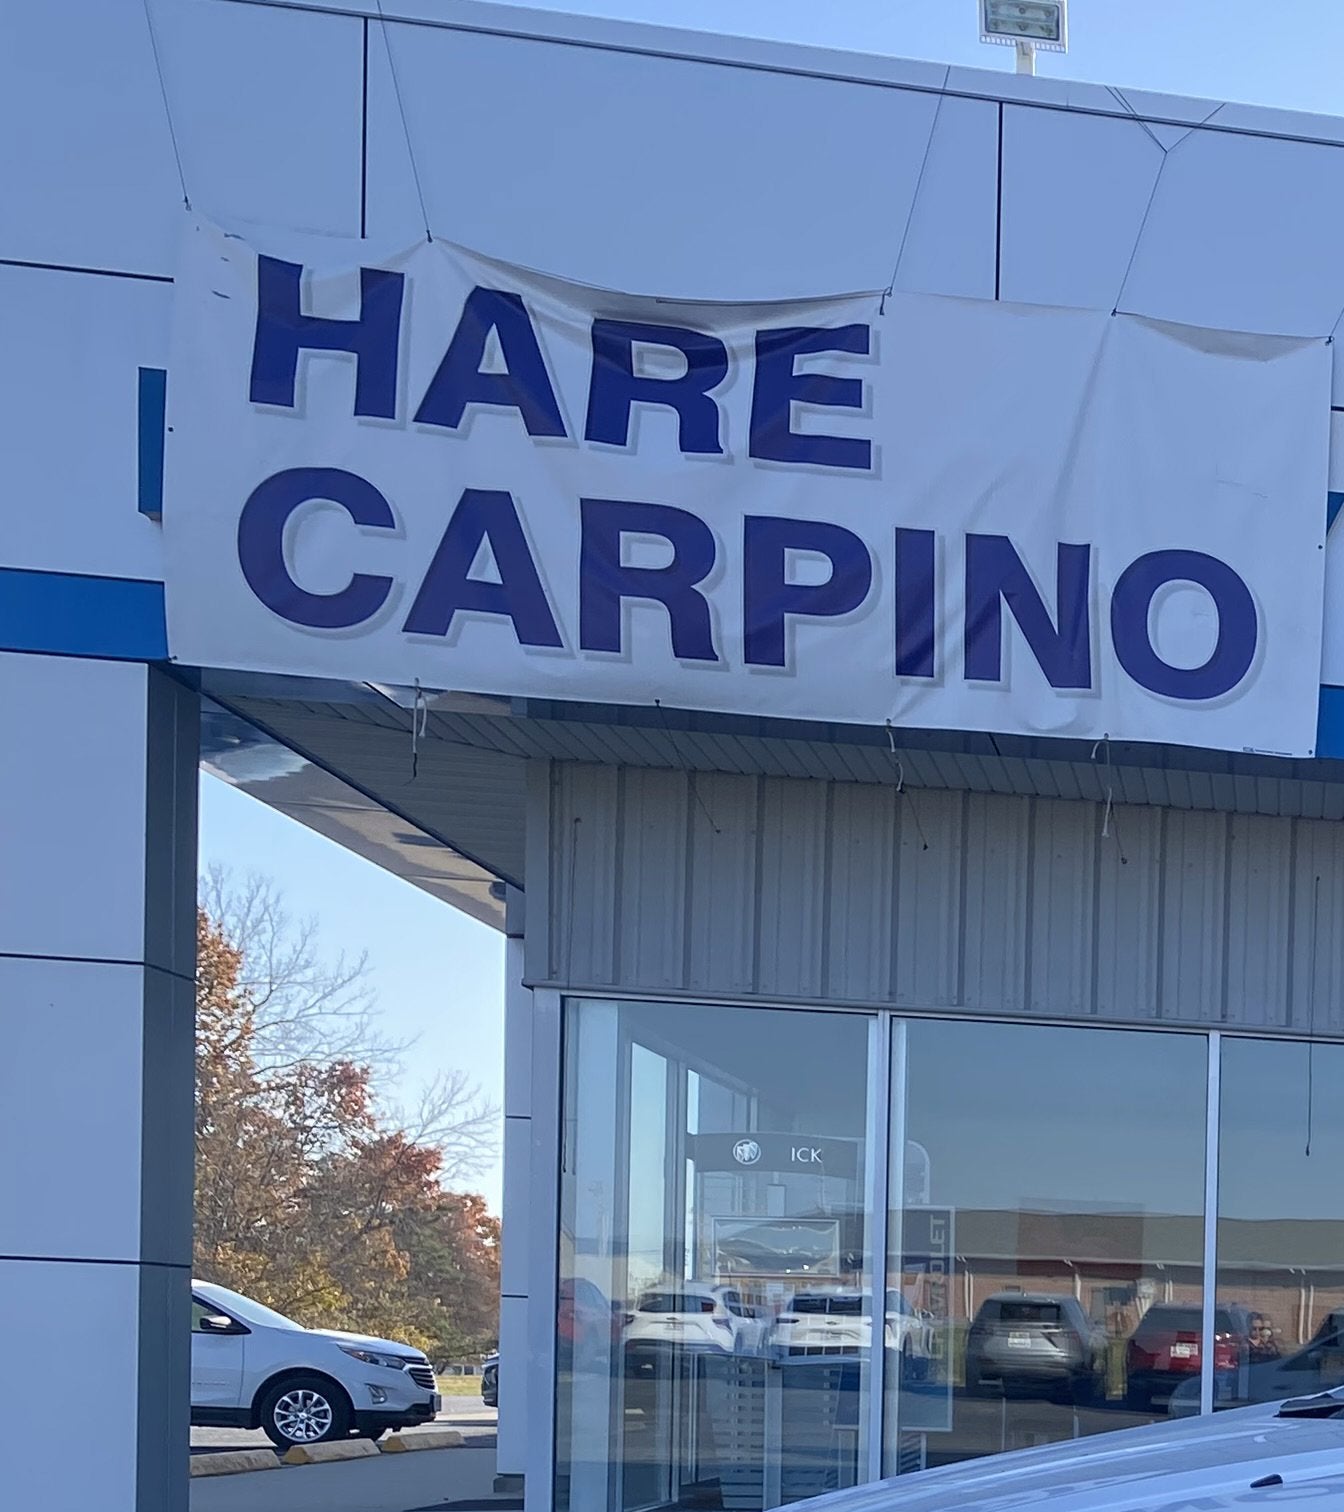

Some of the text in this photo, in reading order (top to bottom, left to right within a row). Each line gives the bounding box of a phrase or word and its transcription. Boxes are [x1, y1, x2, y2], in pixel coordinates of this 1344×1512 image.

[249, 253, 877, 472] HARE
[236, 466, 1260, 702] CARPINO
[790, 1146, 824, 1164] ICK
